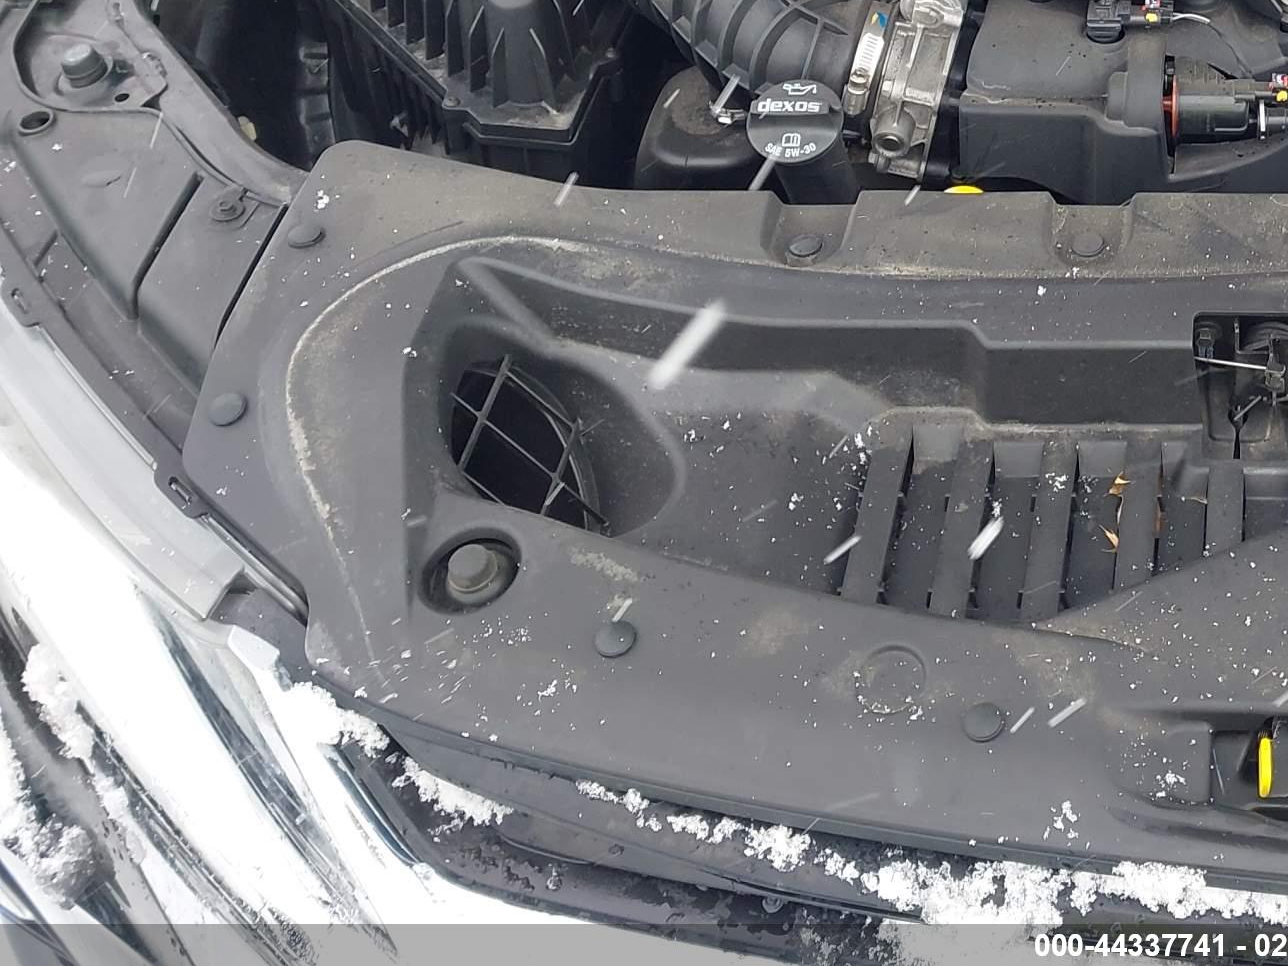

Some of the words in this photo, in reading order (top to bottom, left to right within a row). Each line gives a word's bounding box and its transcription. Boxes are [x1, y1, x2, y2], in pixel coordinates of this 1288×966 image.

[757, 98, 822, 112] dexos
[764, 142, 782, 156] SAE
[784, 142, 816, 158] 5W-30
